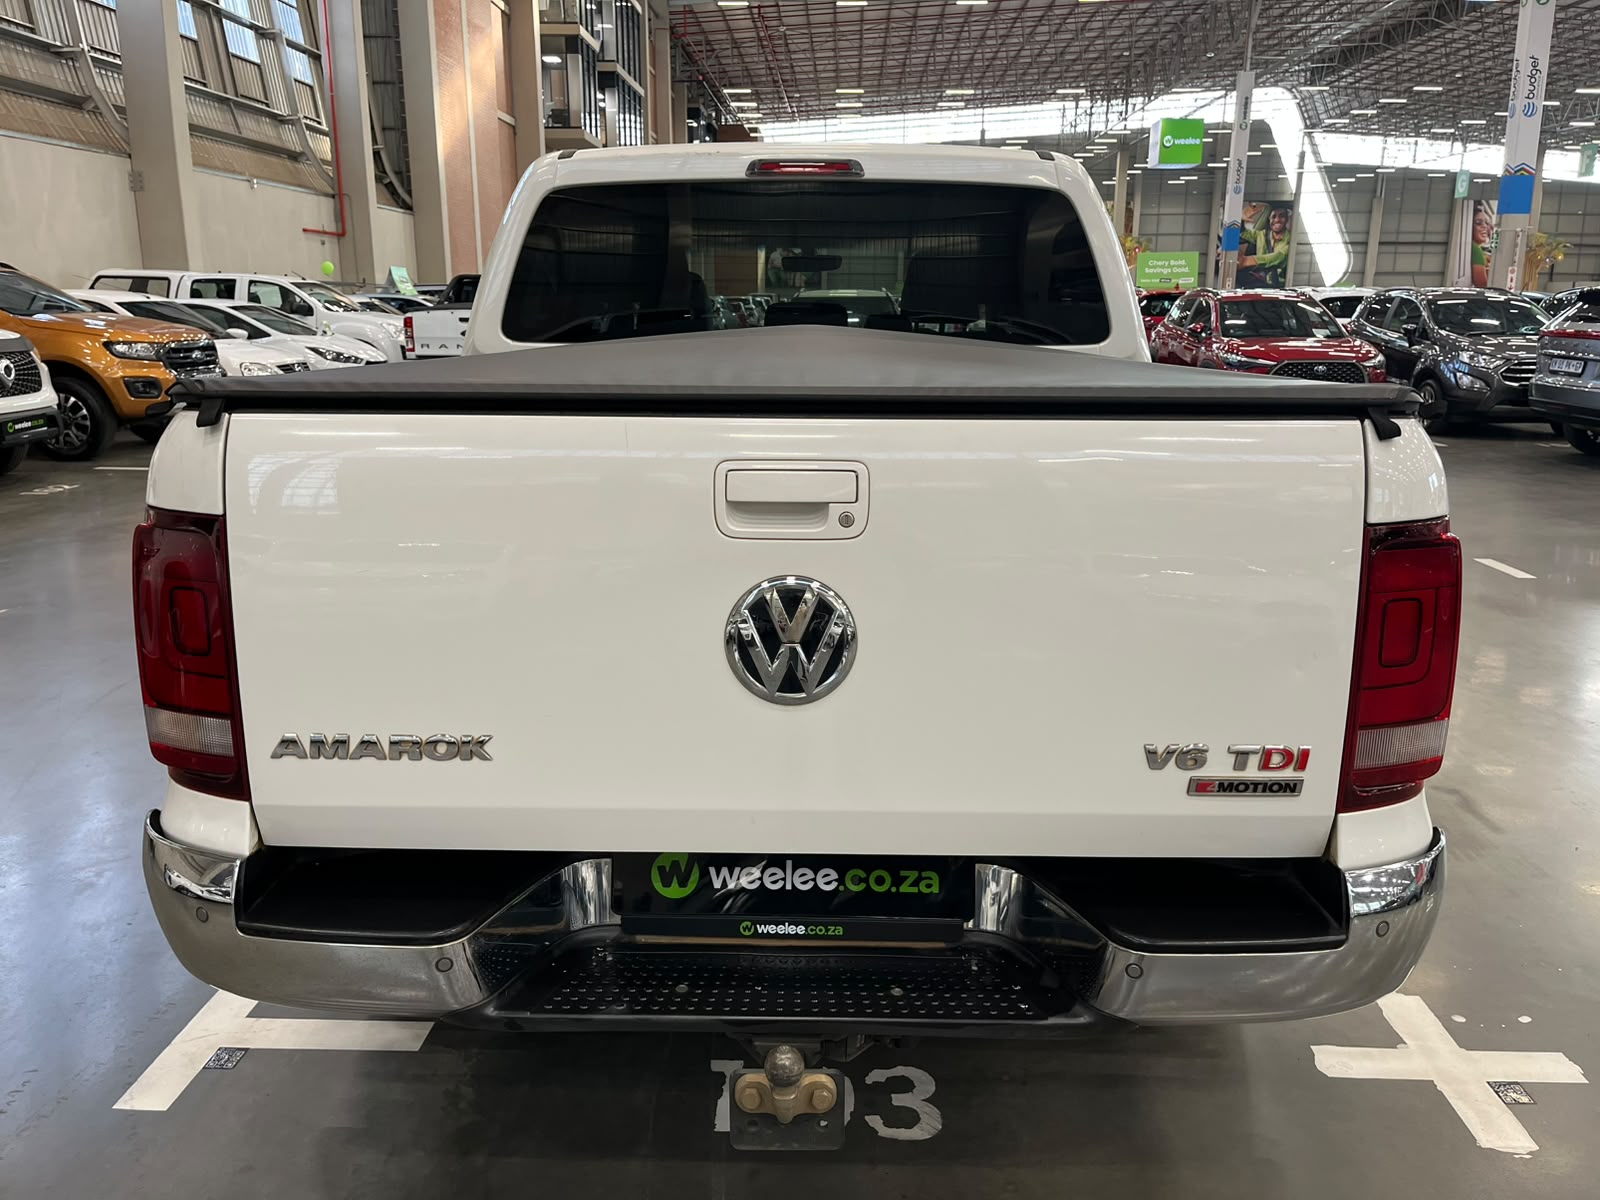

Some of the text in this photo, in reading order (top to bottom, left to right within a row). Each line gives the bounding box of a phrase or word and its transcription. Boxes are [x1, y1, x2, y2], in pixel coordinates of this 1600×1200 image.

[1525, 54, 1542, 100] budget
[1174, 137, 1200, 145] weelee
[1458, 175, 1468, 193] G
[270, 732, 493, 761] AMAROK
[1144, 743, 1312, 771] V6 TDI
[708, 859, 940, 894] weelee.co.za
[756, 922, 843, 936] weelee.co.za
